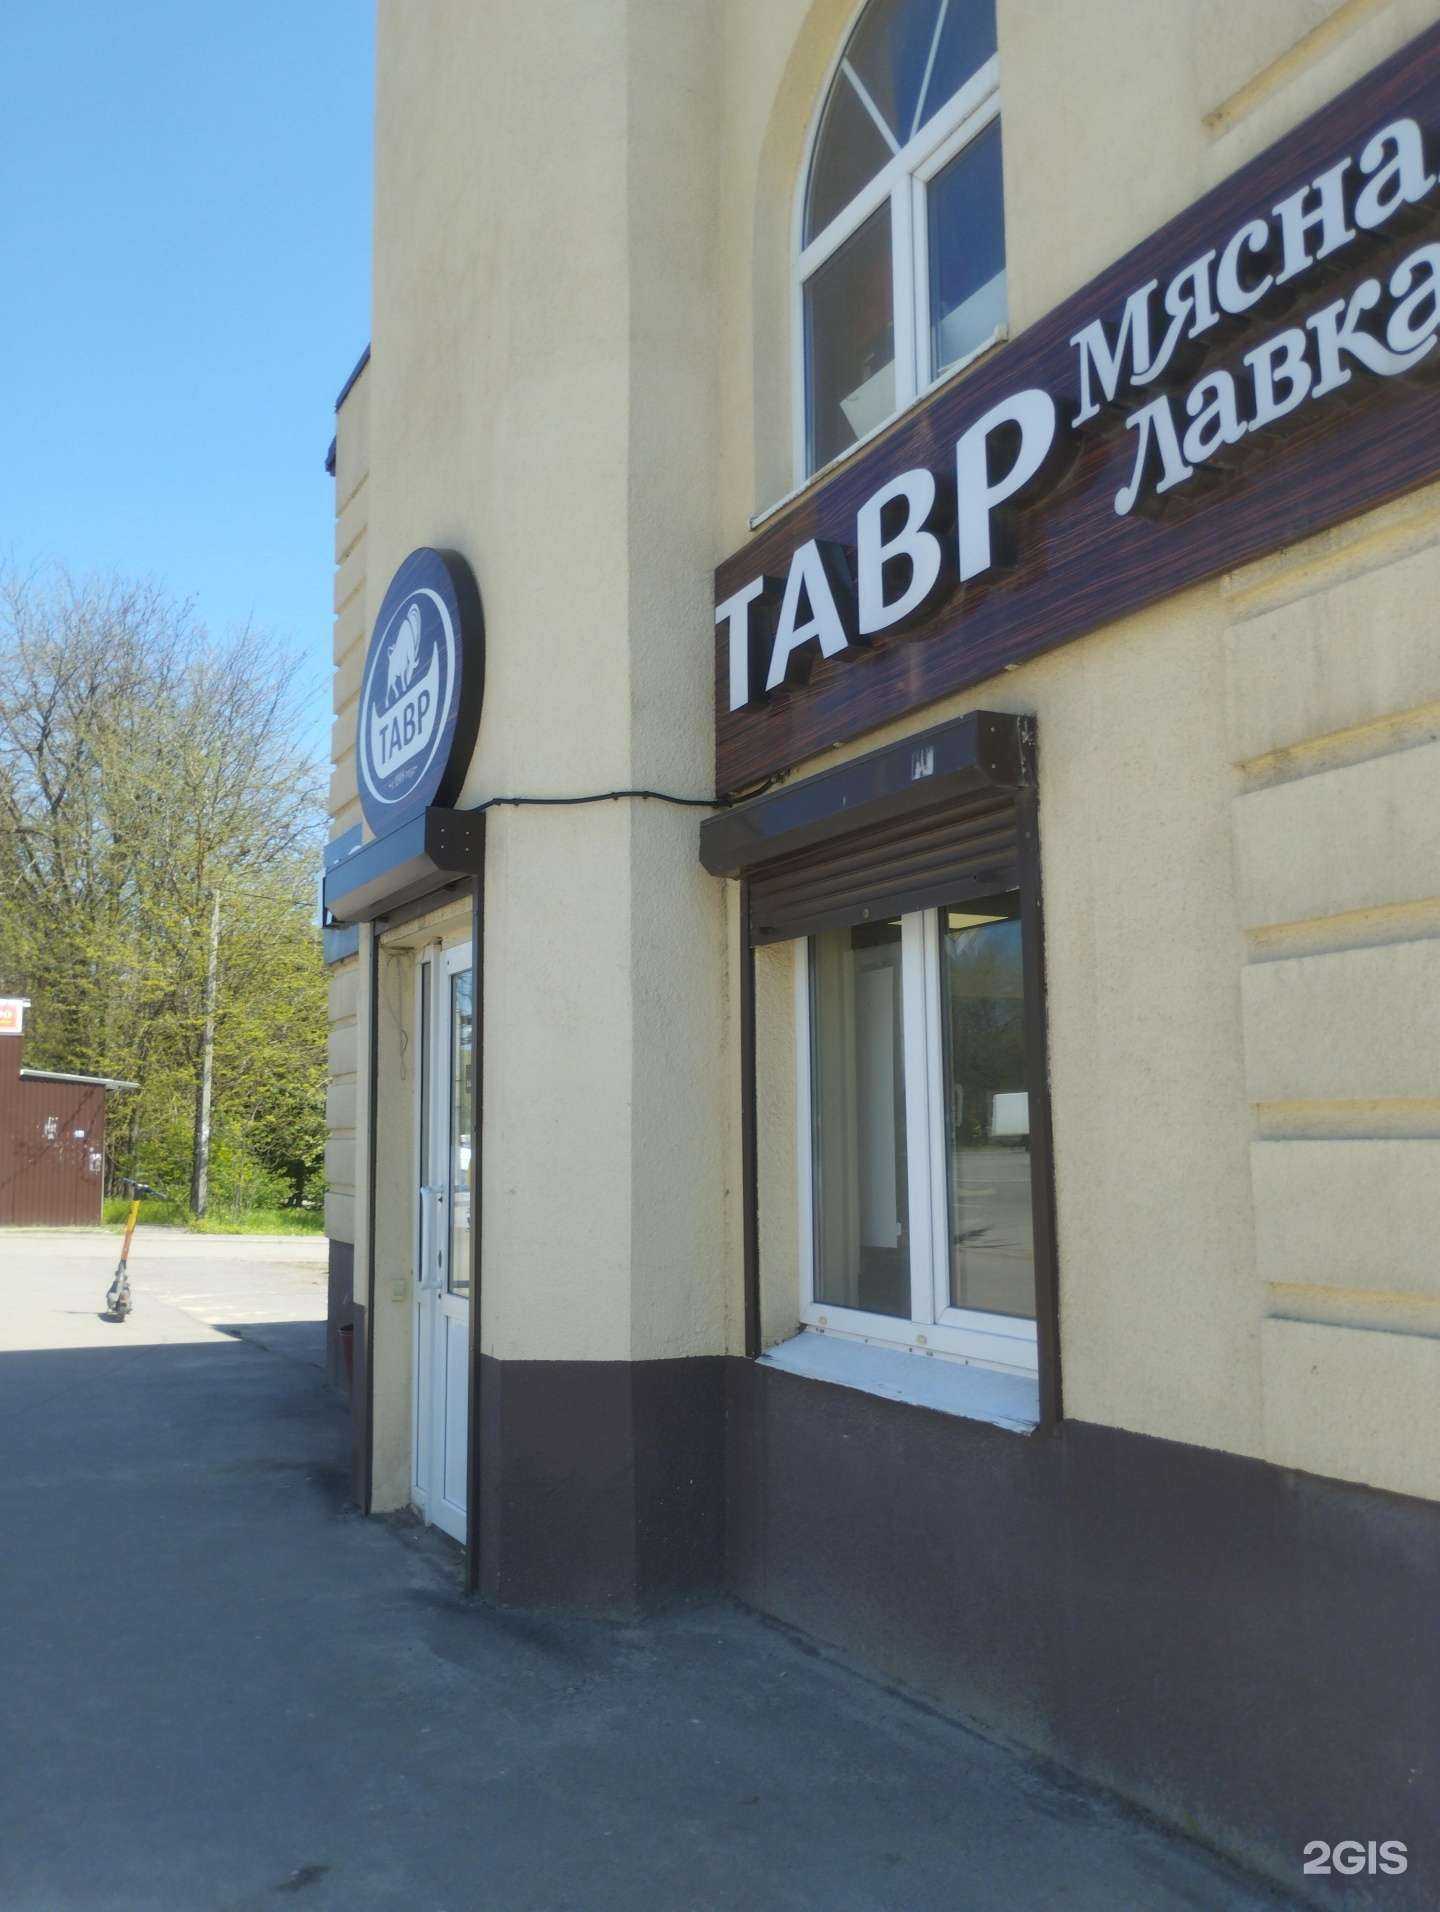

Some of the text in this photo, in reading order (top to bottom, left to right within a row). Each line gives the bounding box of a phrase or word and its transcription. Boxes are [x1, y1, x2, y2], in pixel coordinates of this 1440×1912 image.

[1070, 118, 1440, 428] Мясна
[715, 388, 1056, 712] ТАВР
[379, 689, 431, 765] ТАВР
